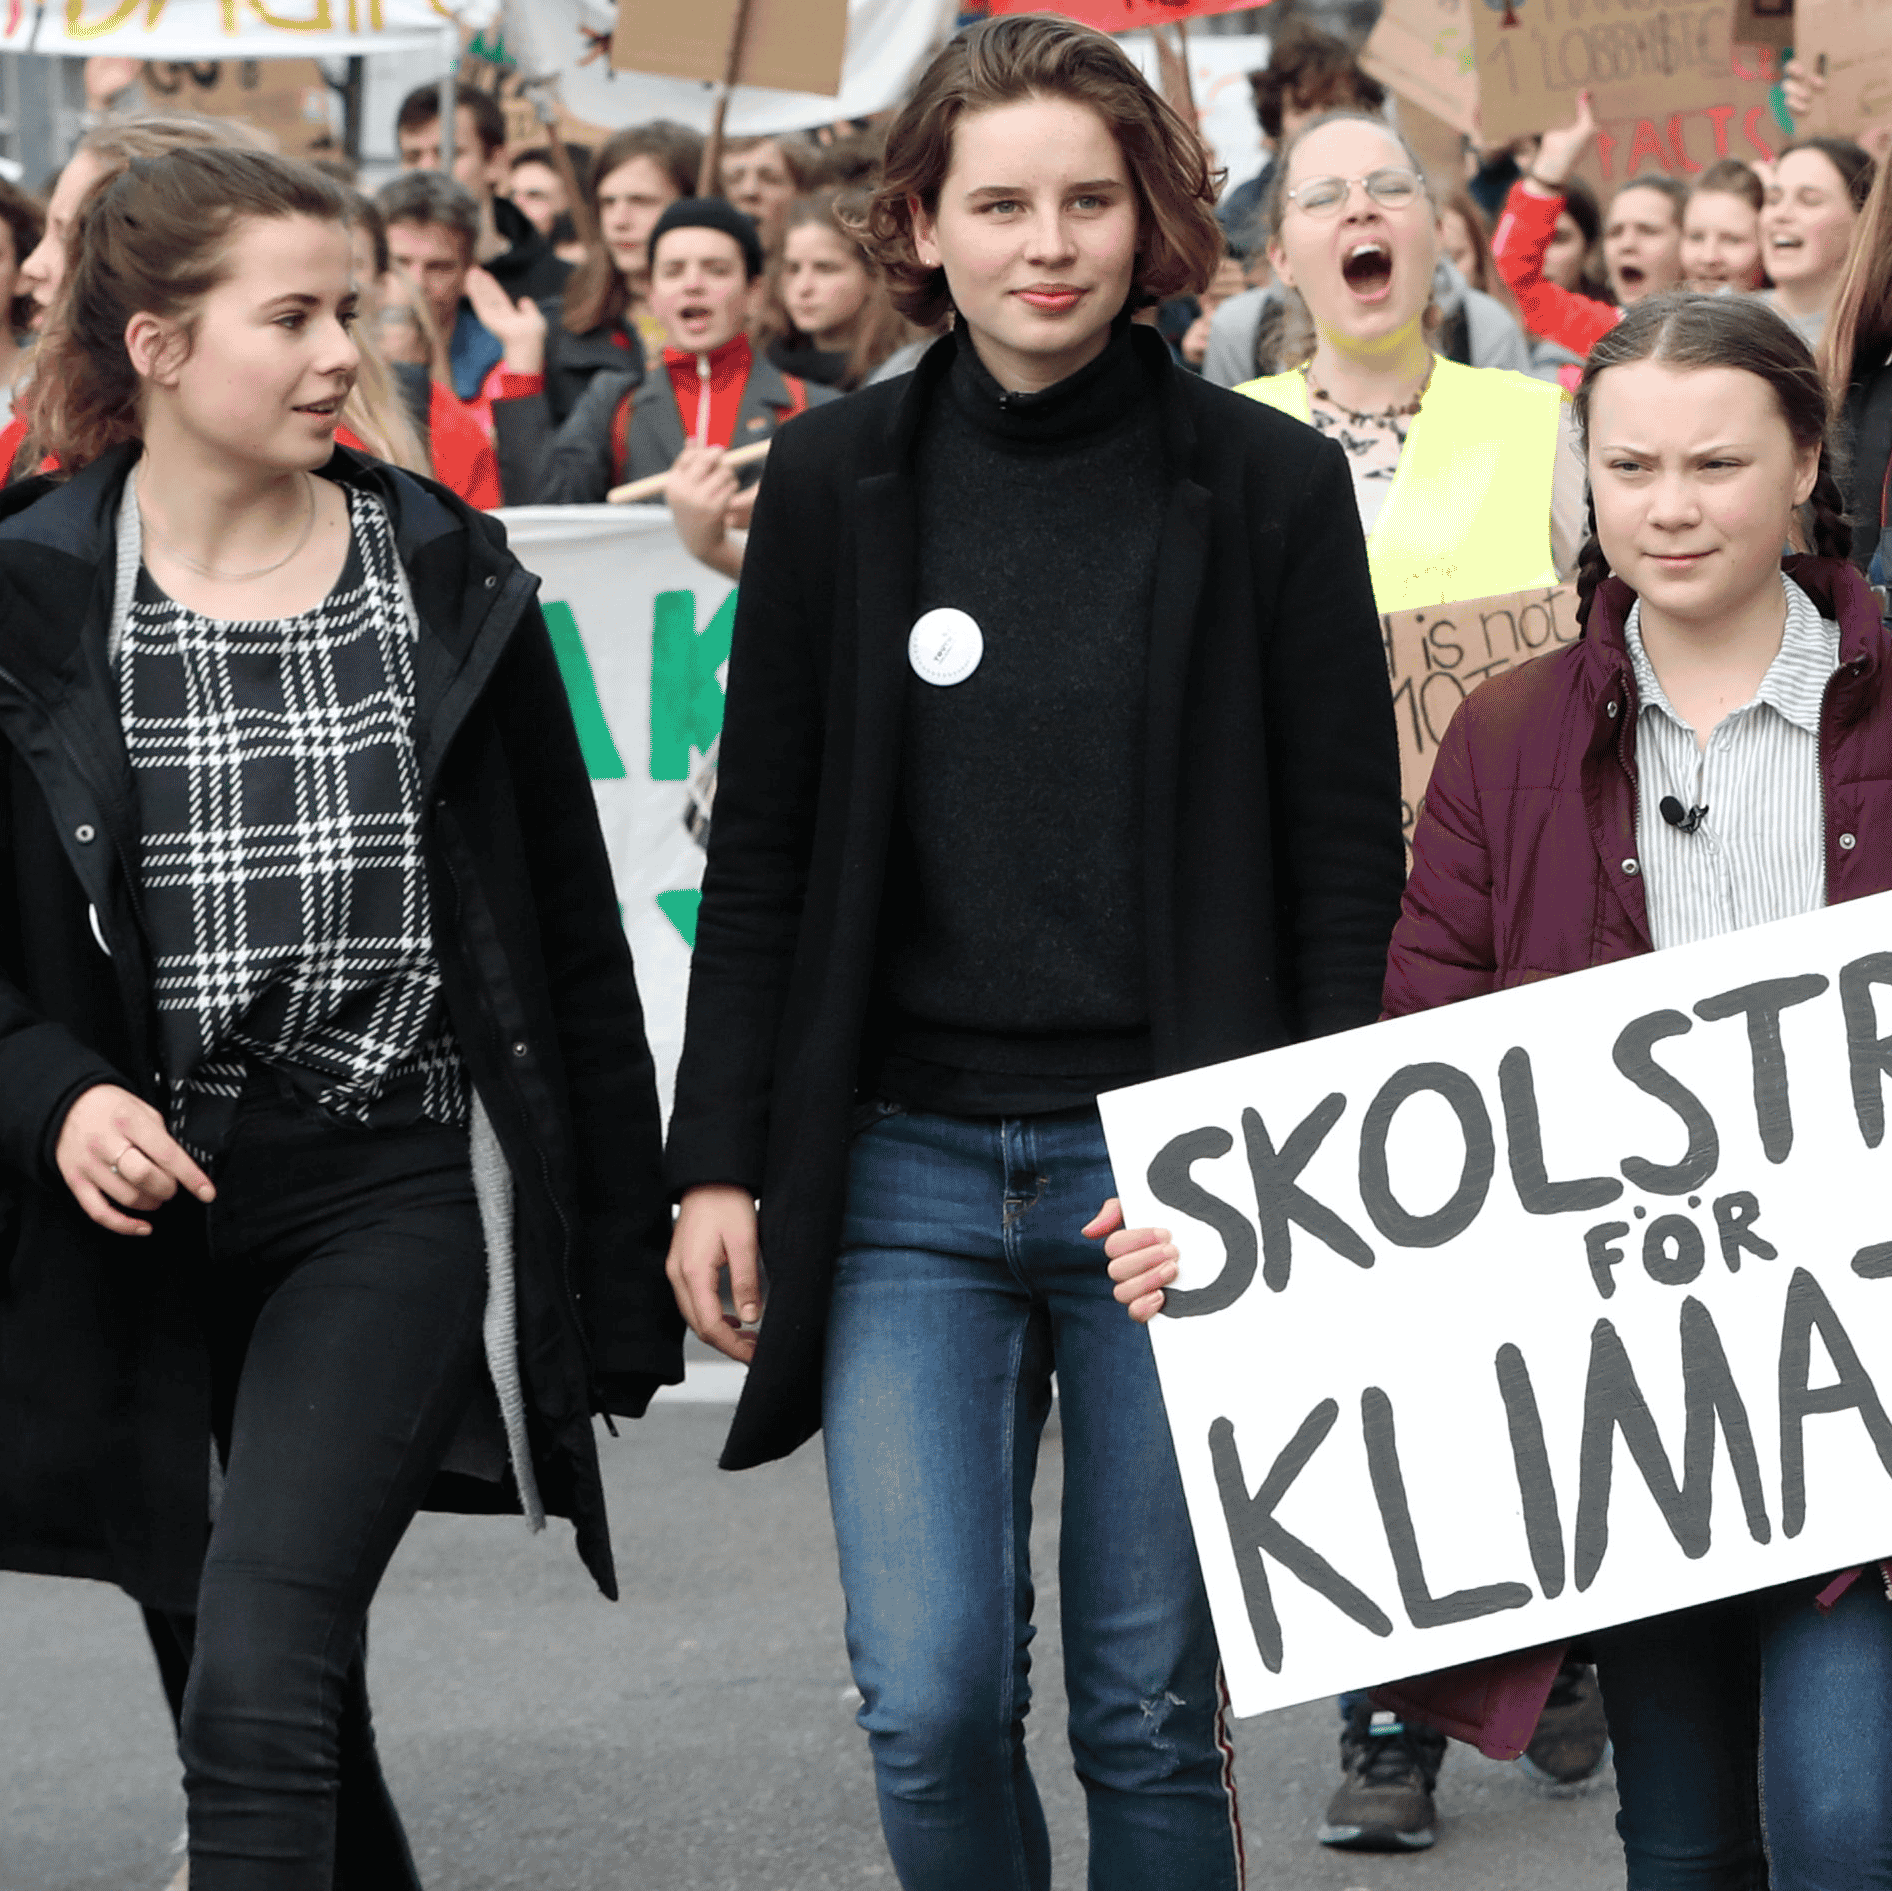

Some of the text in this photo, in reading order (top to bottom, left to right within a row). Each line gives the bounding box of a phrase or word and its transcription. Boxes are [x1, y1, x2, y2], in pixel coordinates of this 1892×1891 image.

[1415, 612, 1465, 671] is
[1478, 588, 1581, 659] not
[1585, 1190, 1776, 1298] FÖR
